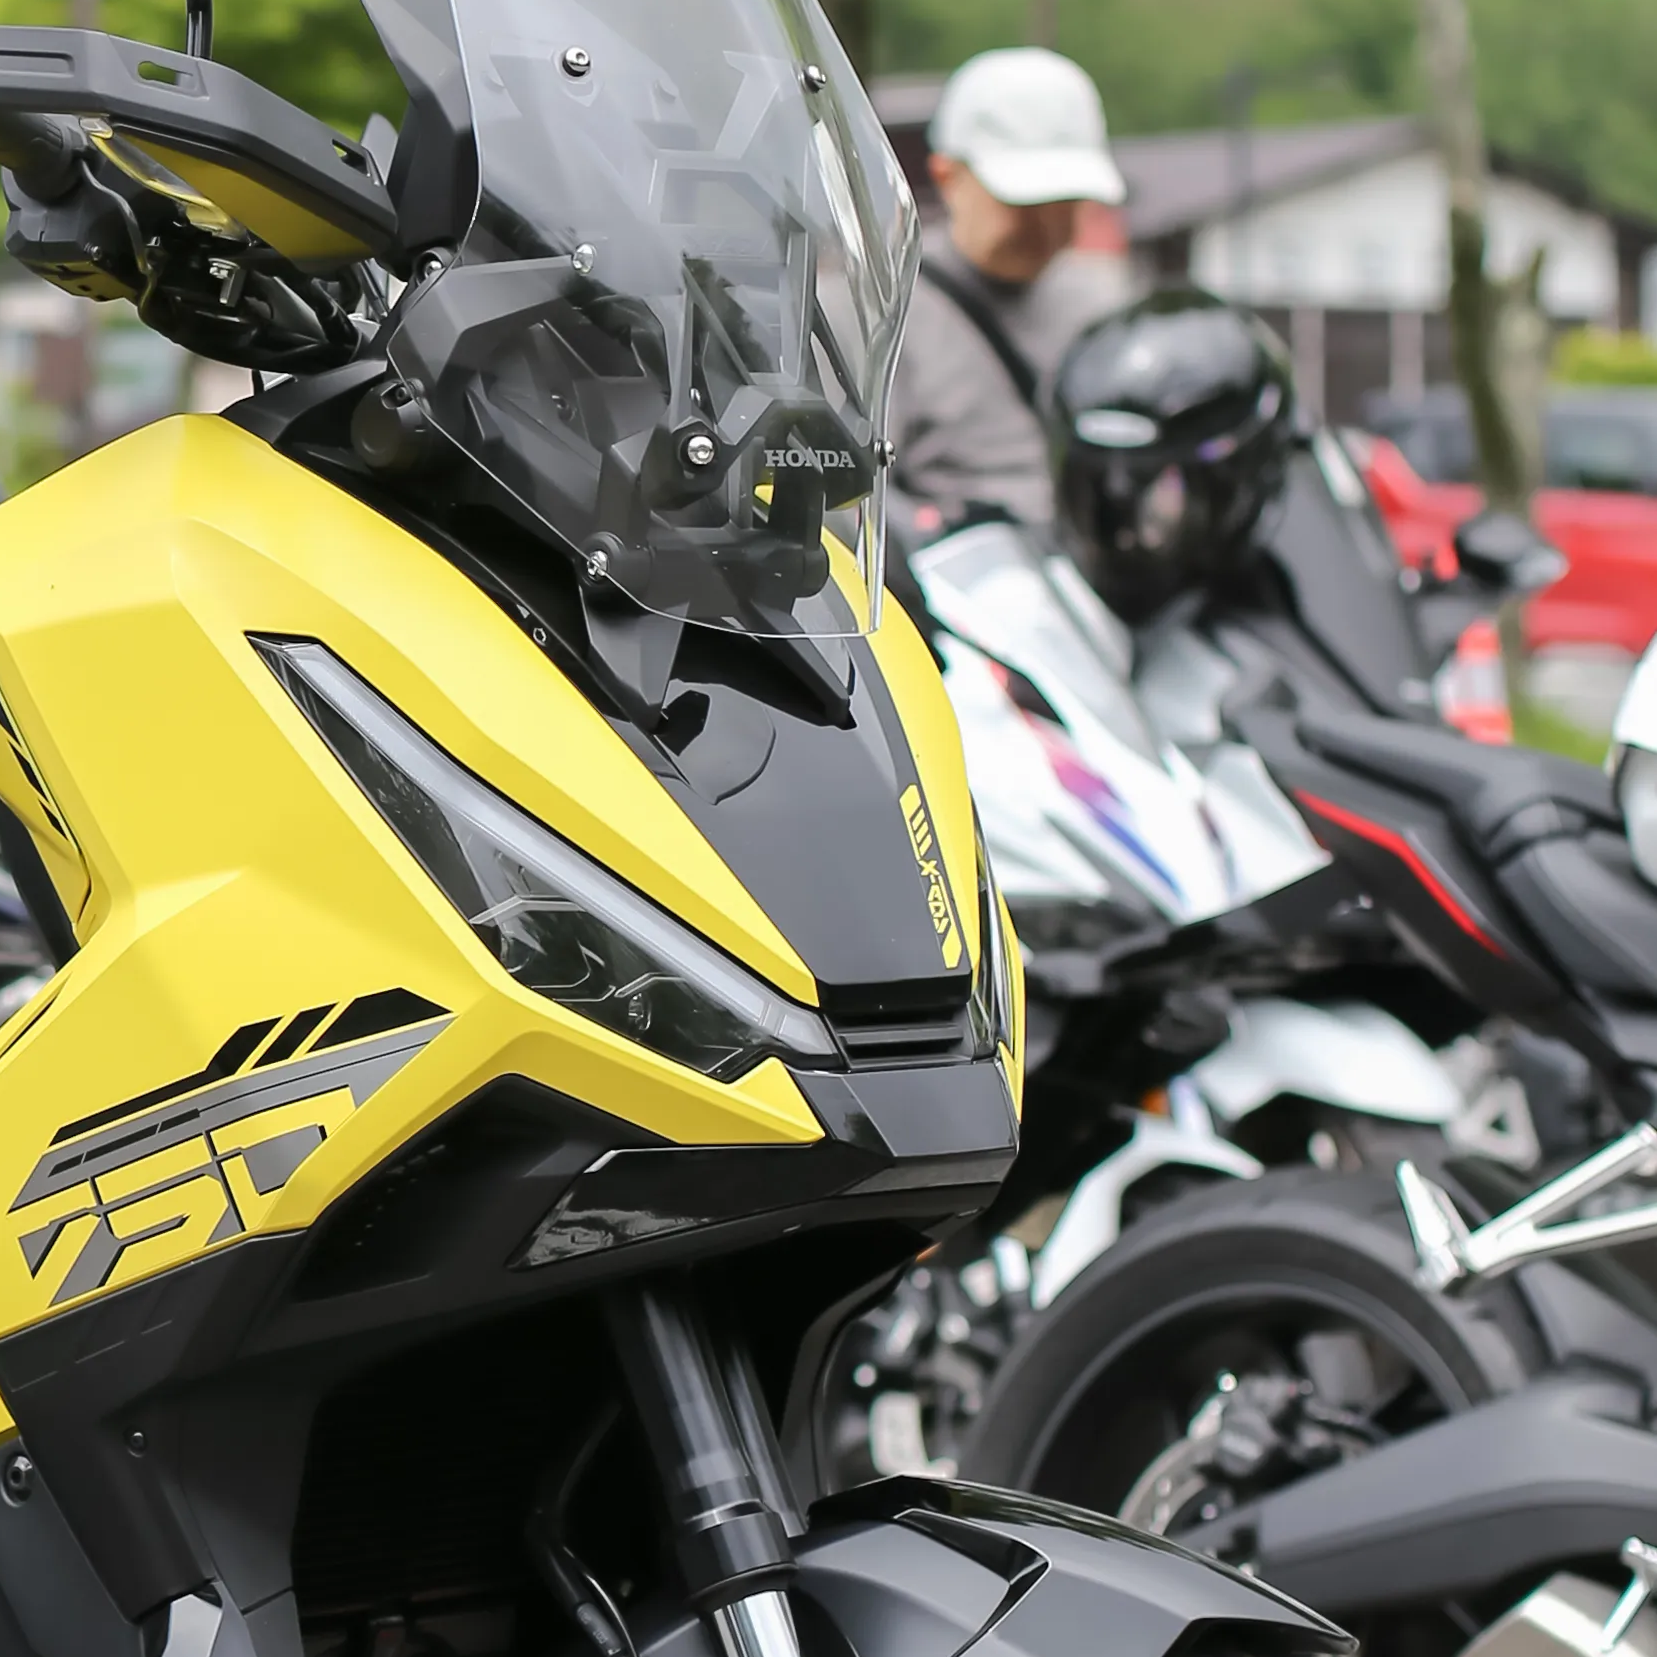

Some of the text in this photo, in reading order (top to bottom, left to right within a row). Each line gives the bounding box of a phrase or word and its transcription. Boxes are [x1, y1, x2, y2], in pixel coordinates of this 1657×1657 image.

[764, 448, 856, 469] HONDA
[918, 860, 950, 934] X-ADV
[6, 1085, 356, 1306] 750
